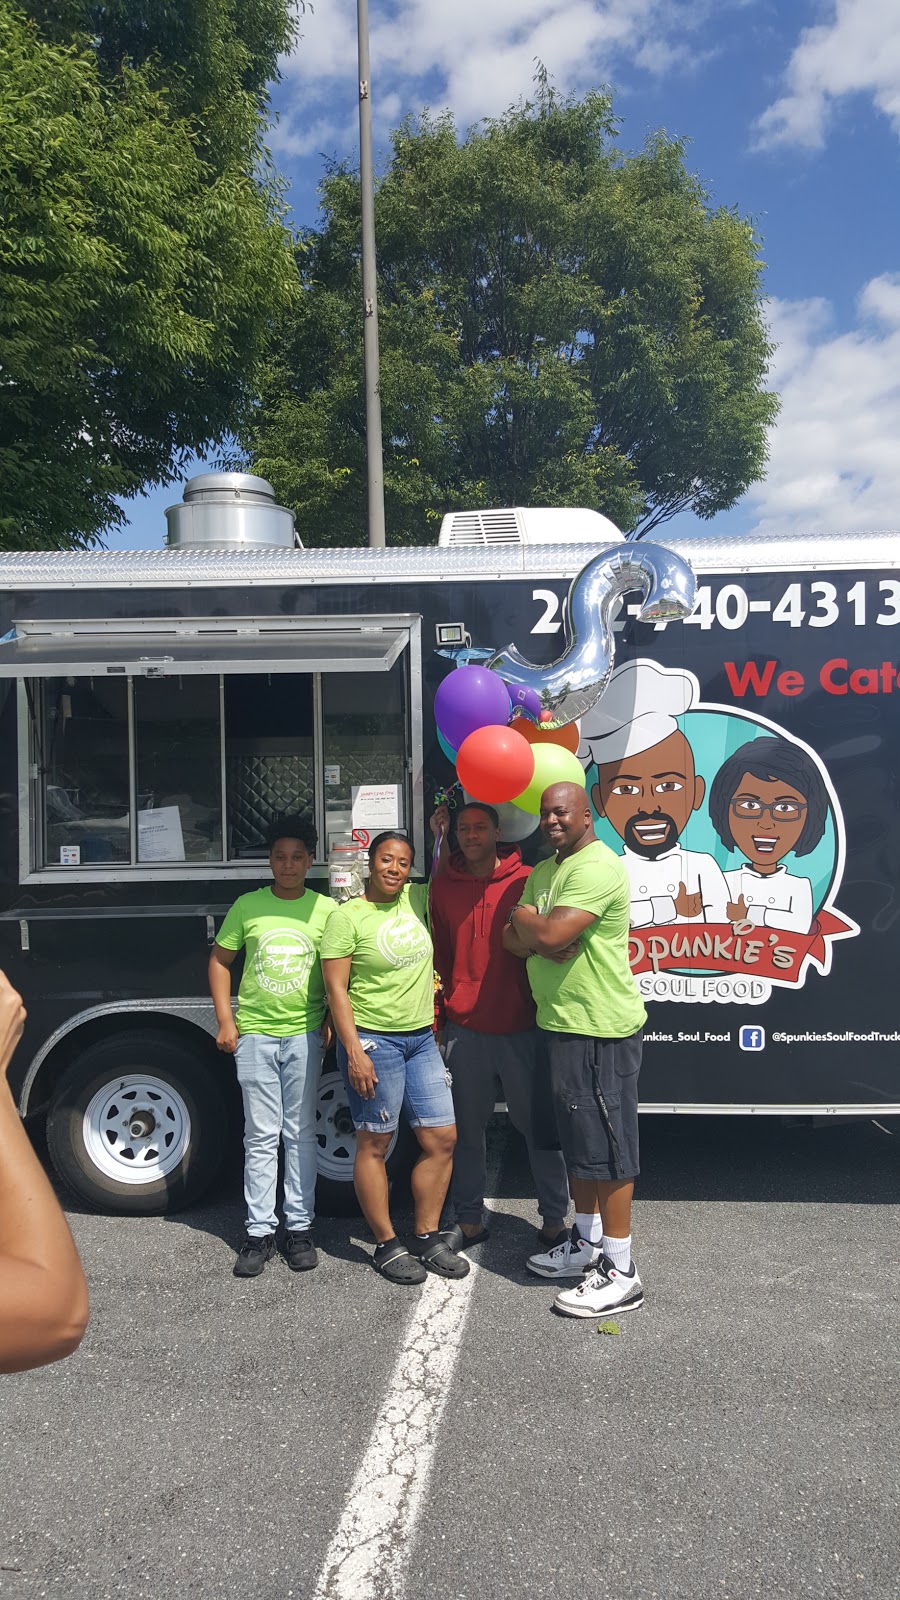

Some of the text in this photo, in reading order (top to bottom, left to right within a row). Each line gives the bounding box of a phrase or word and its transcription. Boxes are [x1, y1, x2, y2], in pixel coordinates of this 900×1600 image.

[530, 580, 900, 634] 22-40-4313
[724, 657, 900, 697] We Cat
[262, 977, 301, 994] SQUAD
[640, 978, 766, 998] SOUL FOOD
